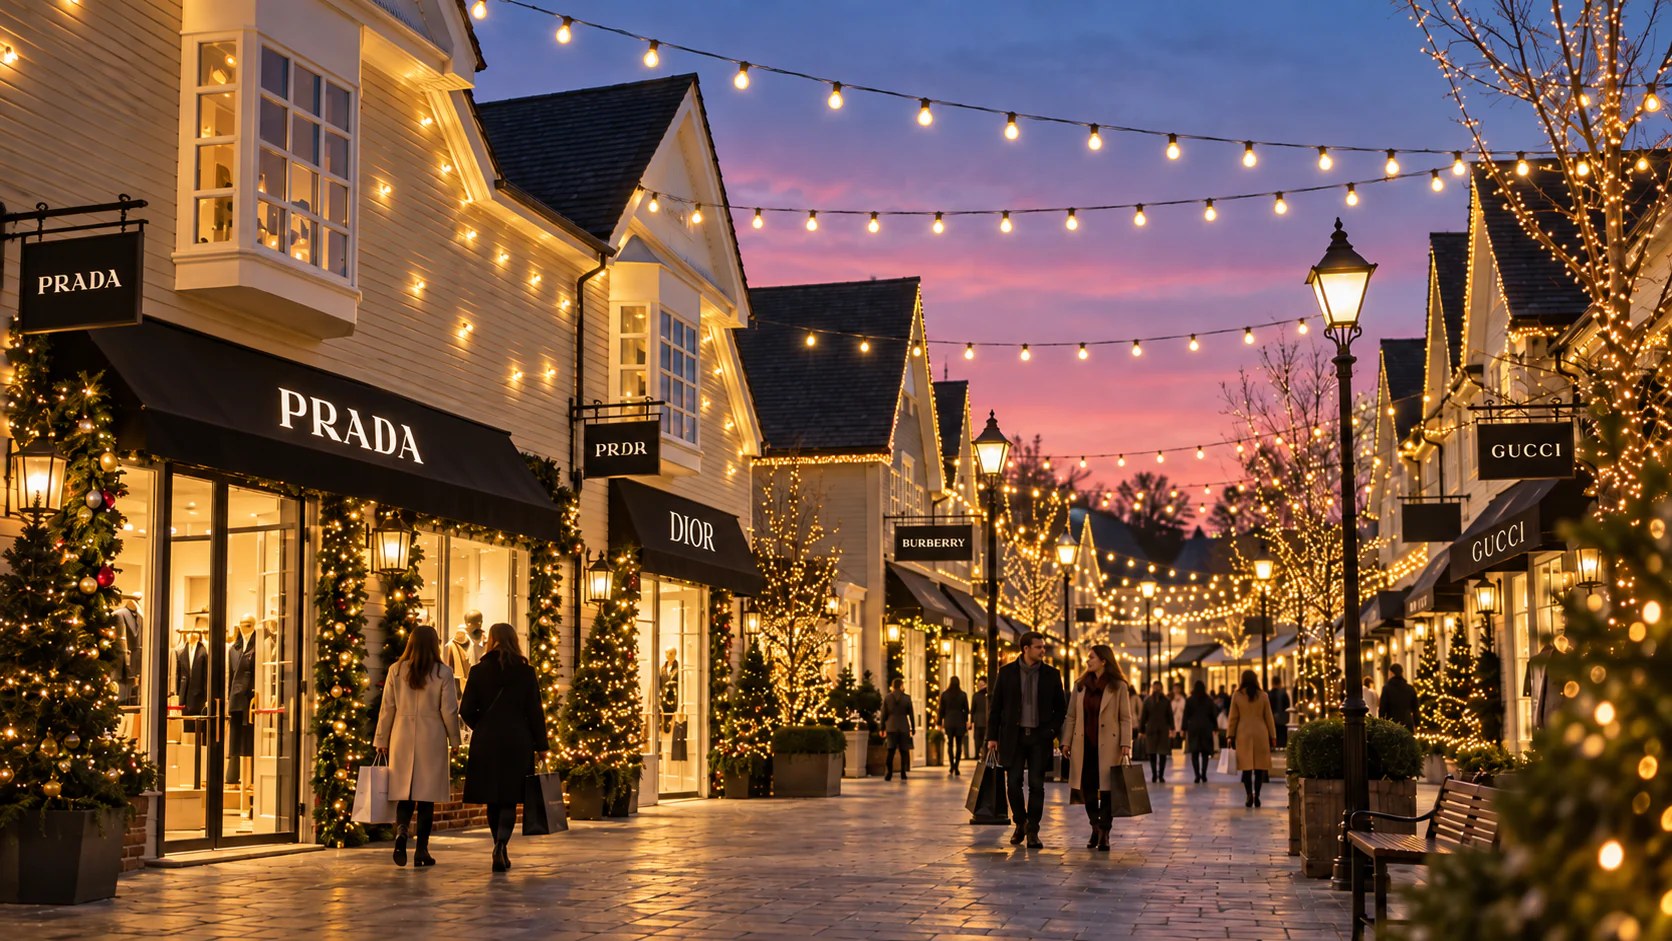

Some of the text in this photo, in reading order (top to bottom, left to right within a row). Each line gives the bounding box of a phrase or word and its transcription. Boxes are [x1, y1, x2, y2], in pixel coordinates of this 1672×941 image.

[37, 269, 122, 295] PRADA
[278, 387, 424, 464] PRADA
[595, 441, 648, 457] PRDR
[1491, 443, 1561, 459] GUCCI
[669, 510, 716, 552] DIOR
[902, 538, 965, 548] BURBERRY
[1472, 521, 1525, 563] GUCCI
